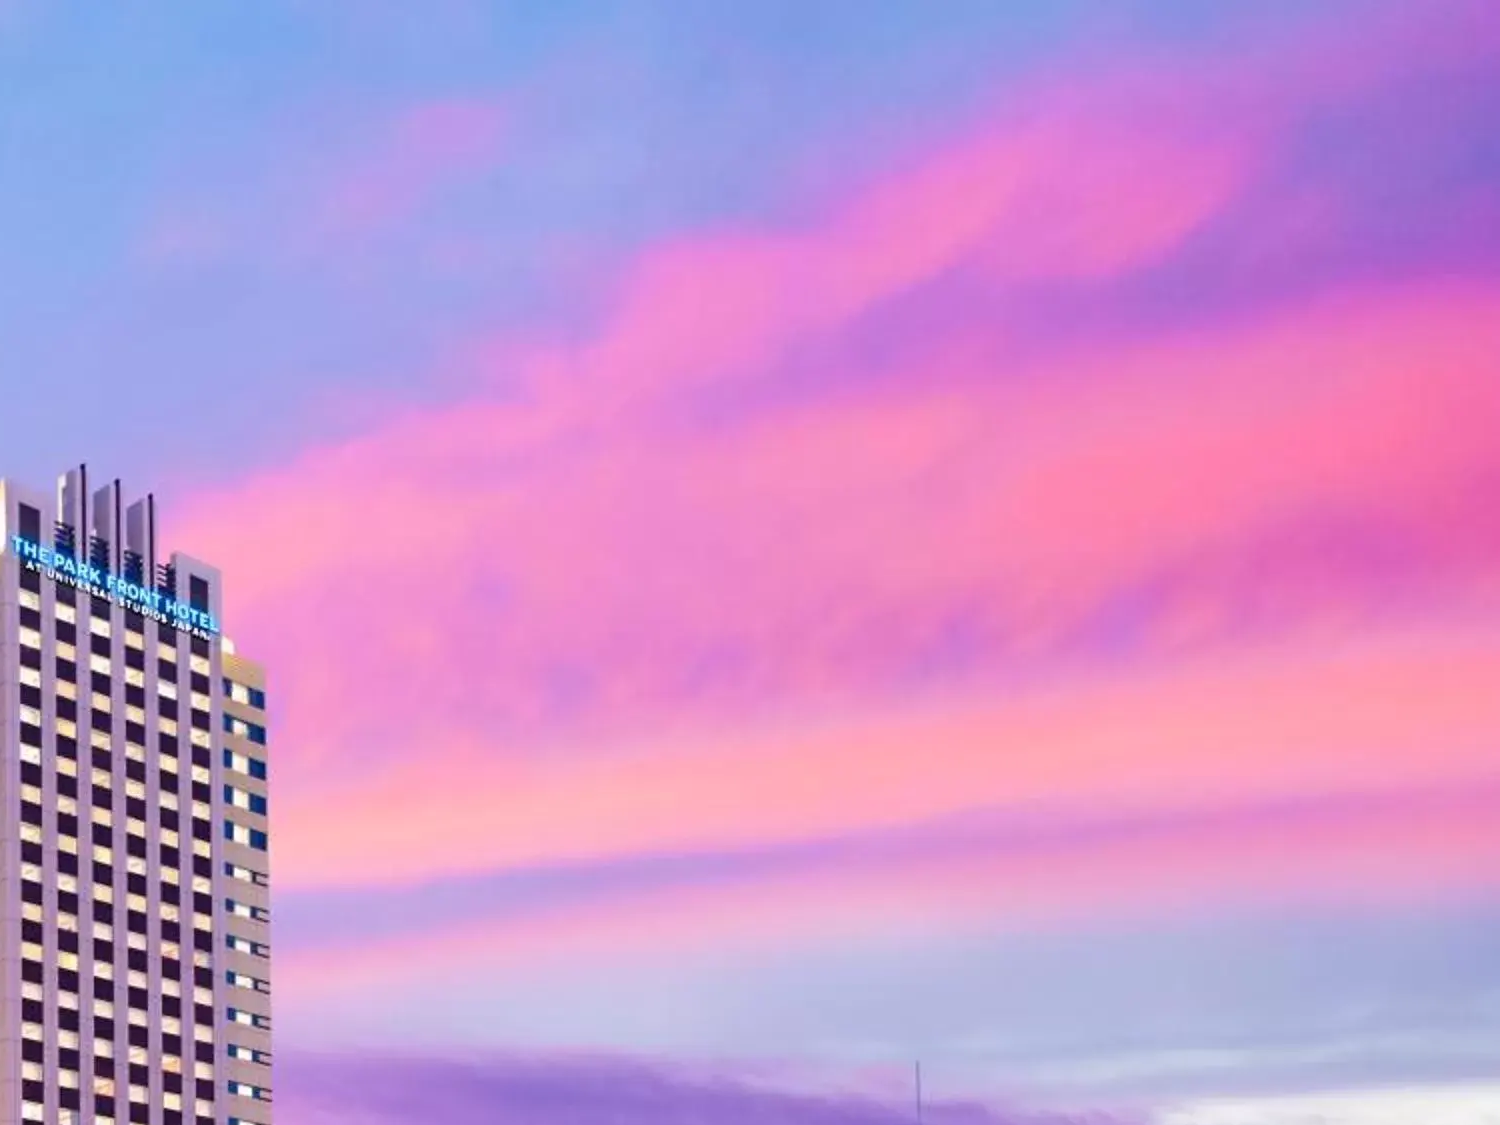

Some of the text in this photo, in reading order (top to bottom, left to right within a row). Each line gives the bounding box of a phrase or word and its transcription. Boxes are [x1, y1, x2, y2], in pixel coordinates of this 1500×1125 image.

[12, 534, 219, 633] THE PARK FRONT HOTEL
[25, 559, 41, 573] AT
[47, 567, 113, 602] UNIVERSAL
[119, 596, 168, 624] STUDIOS
